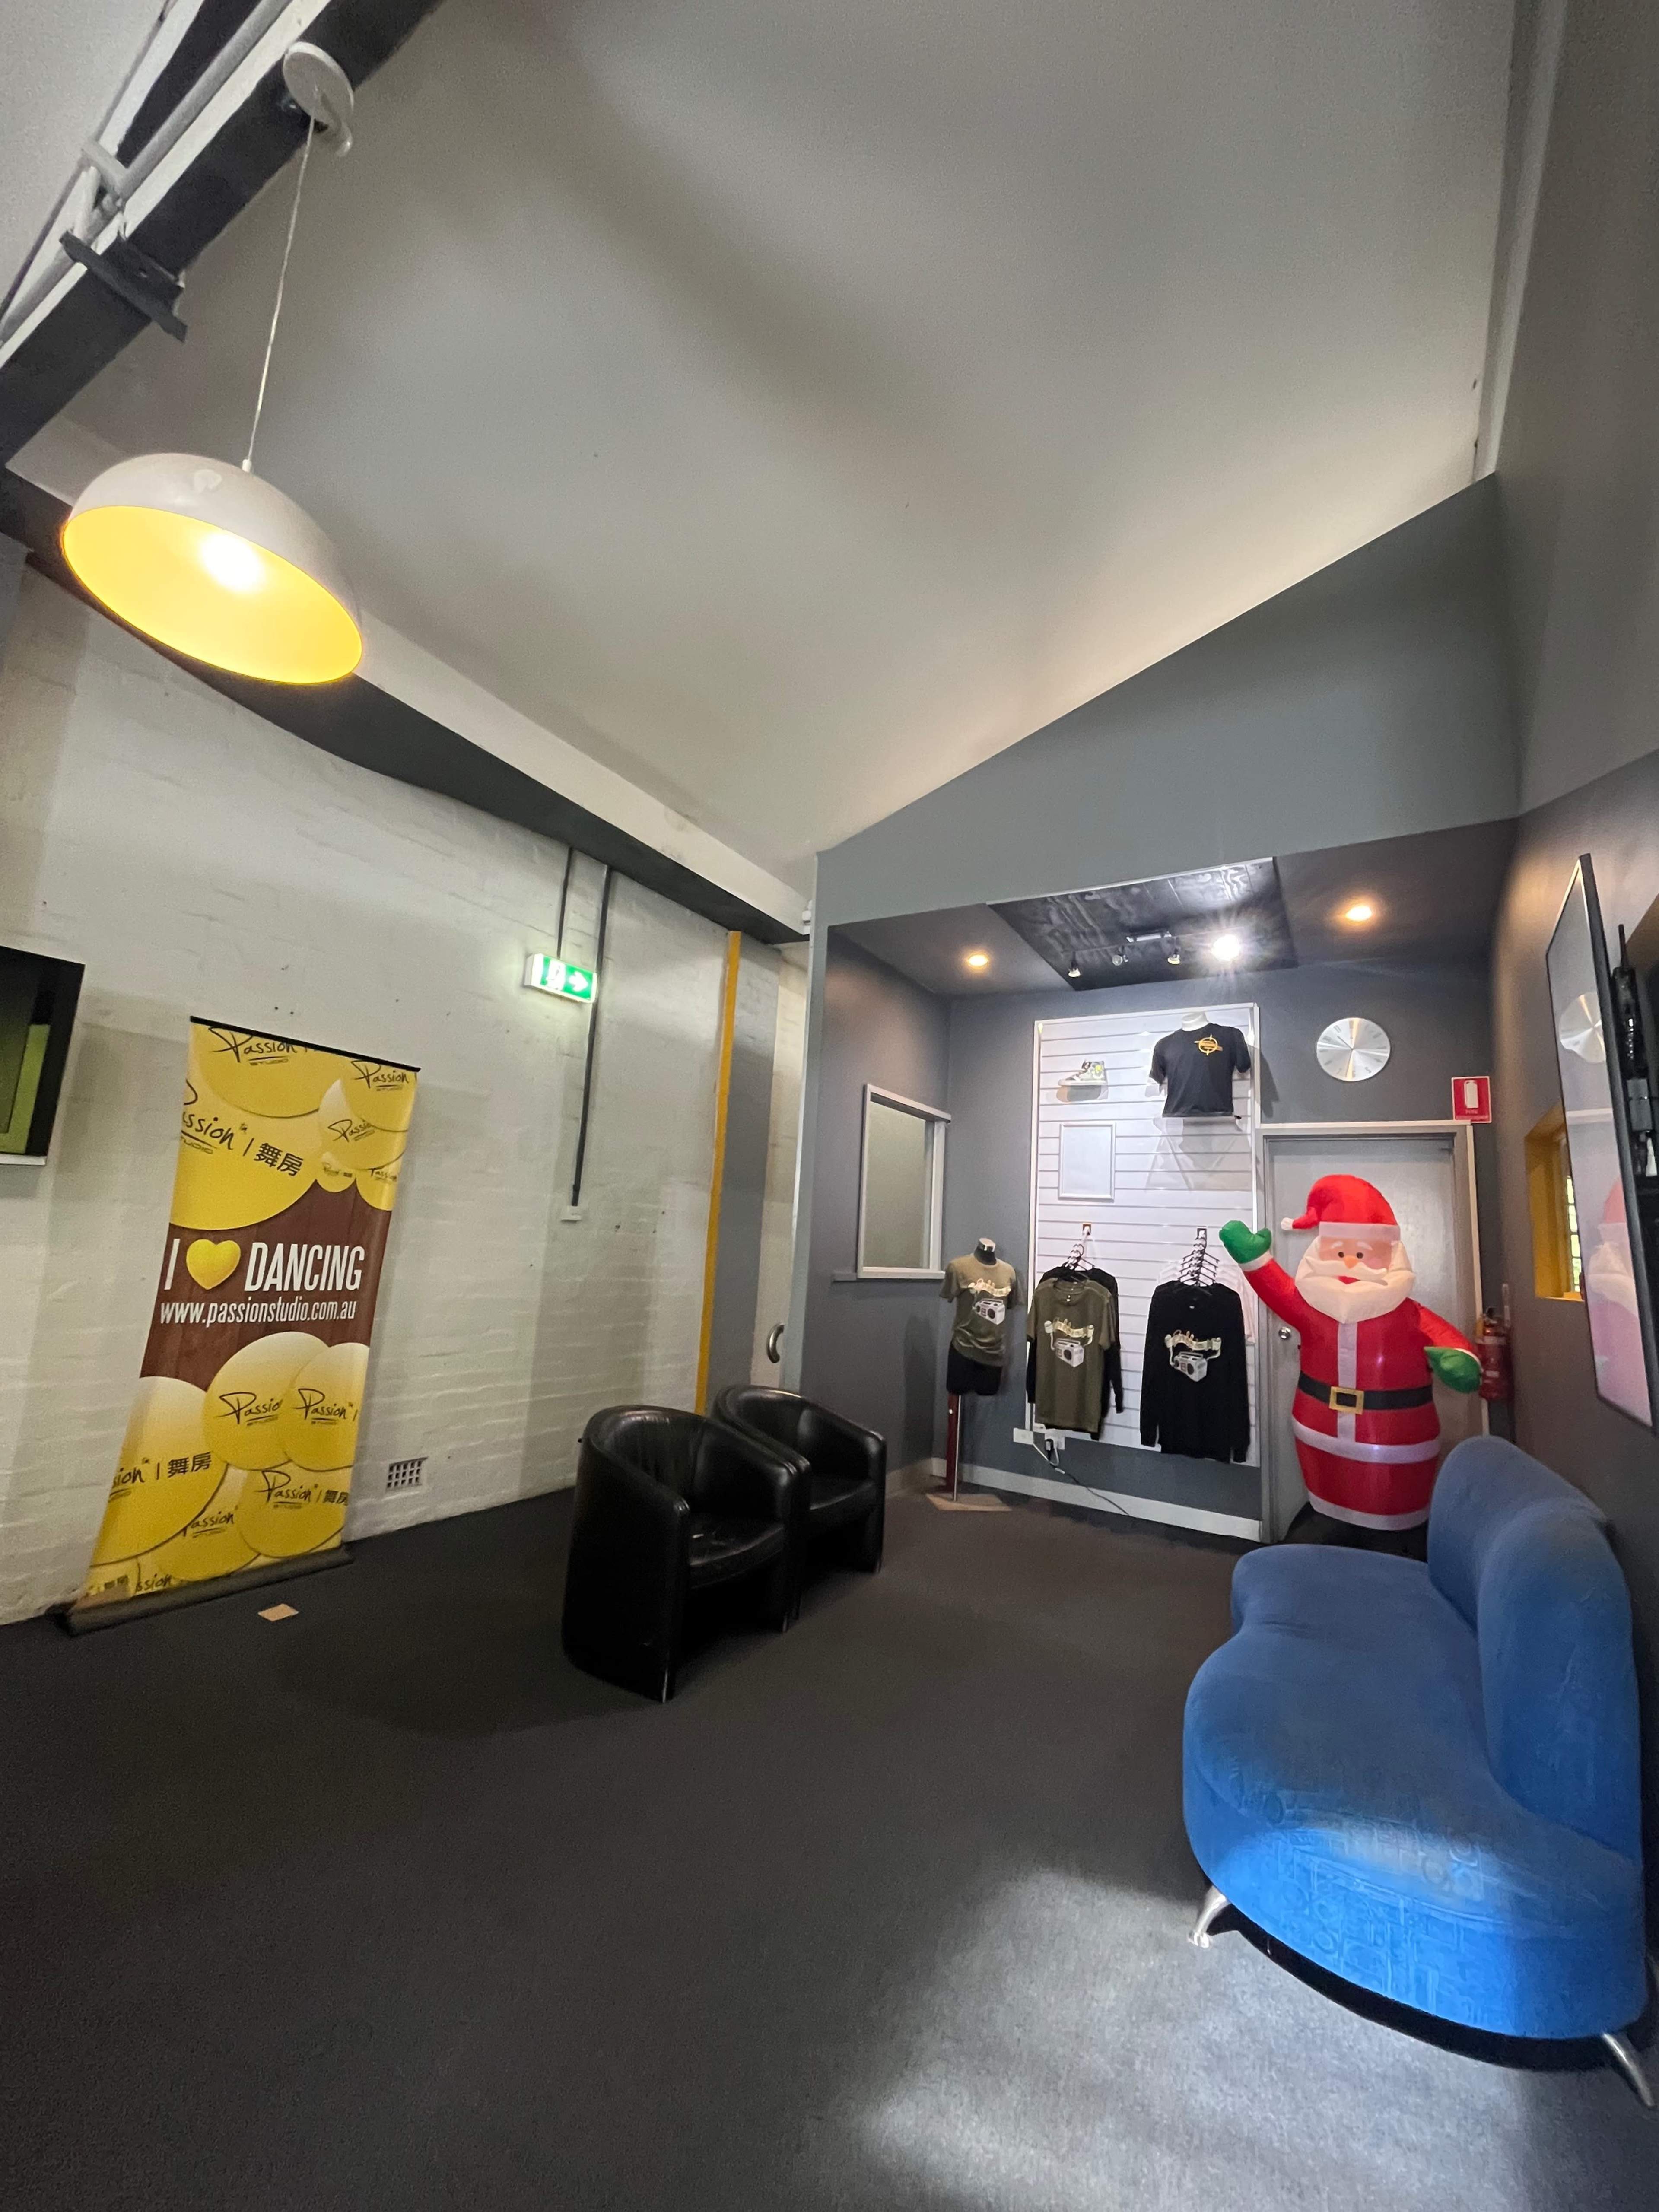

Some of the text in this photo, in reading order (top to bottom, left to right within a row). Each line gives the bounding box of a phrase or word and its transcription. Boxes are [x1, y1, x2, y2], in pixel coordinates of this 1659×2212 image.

[208, 1027, 298, 1063] Passion
[351, 1060, 409, 1089] Passion
[254, 1142, 304, 1176] 舞房
[165, 1238, 365, 1291] I DANCING
[160, 1296, 357, 1328] www.passionstudio.com.au
[291, 1388, 346, 1420] Passion
[255, 1470, 311, 1503] Passion
